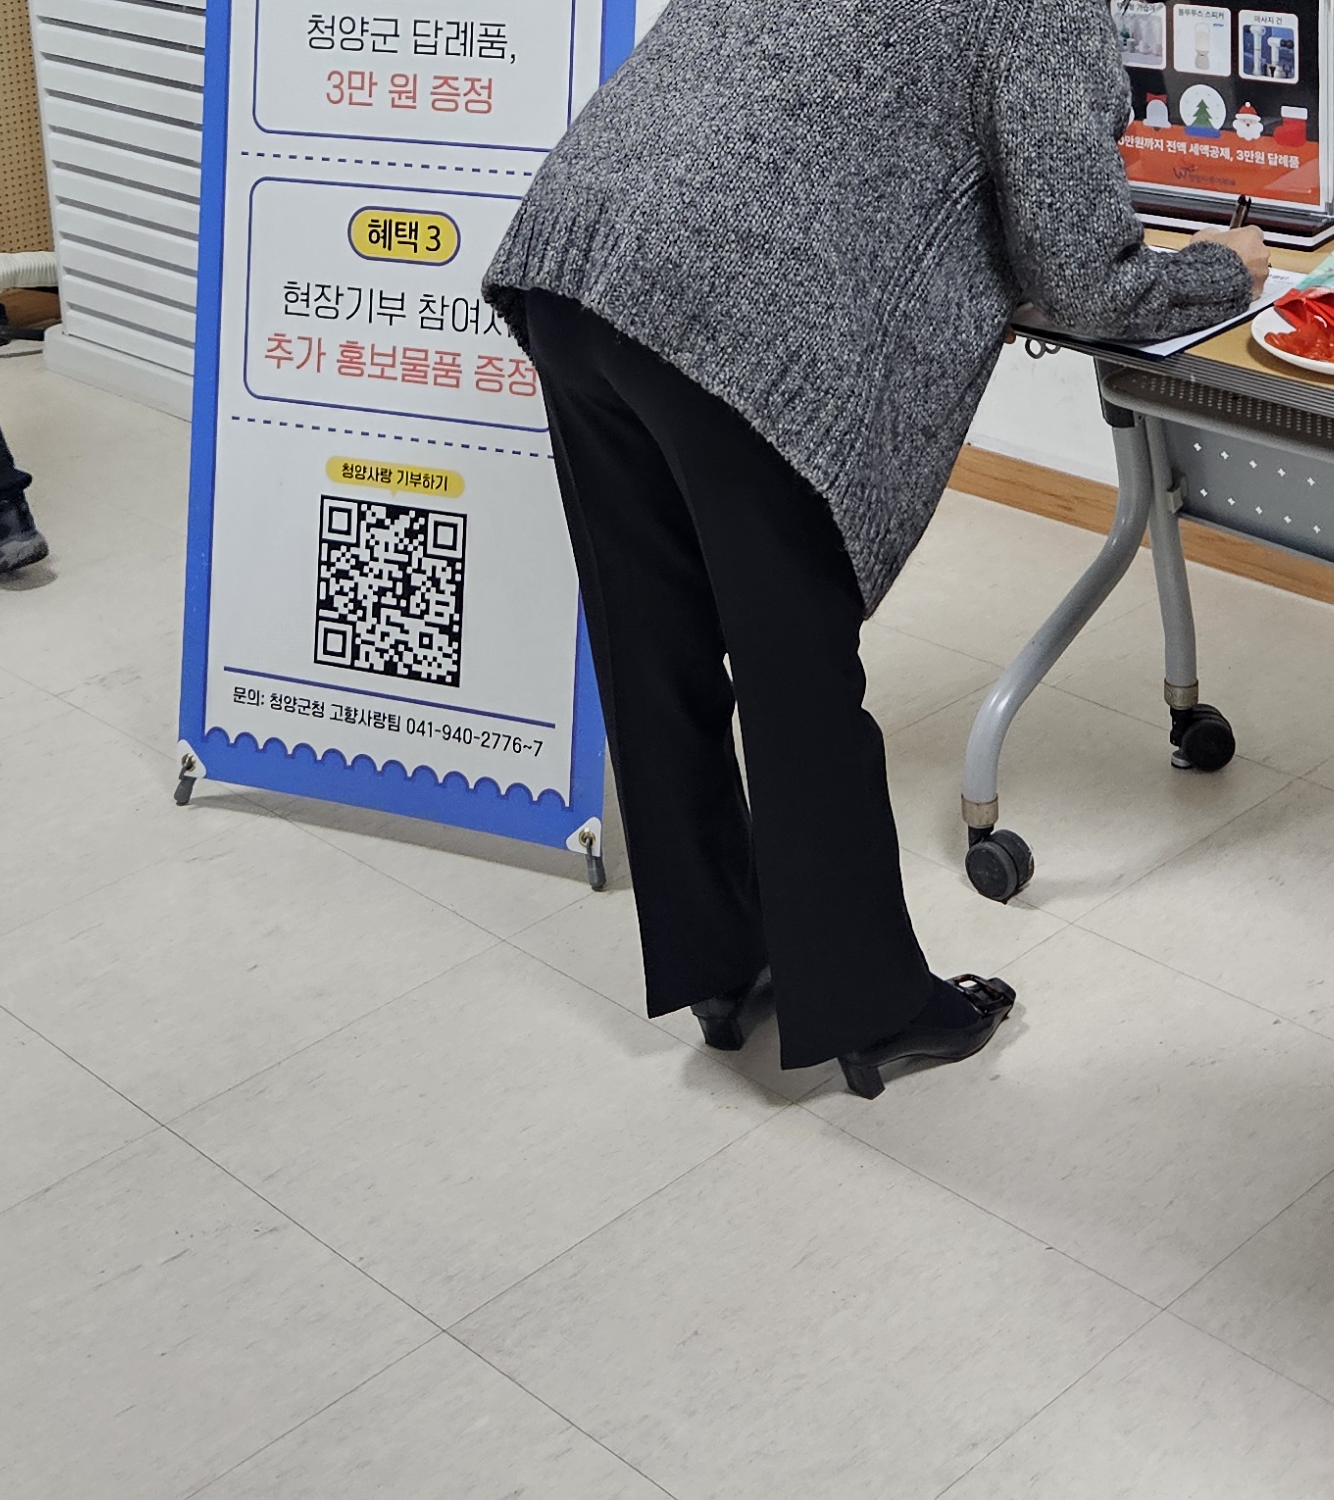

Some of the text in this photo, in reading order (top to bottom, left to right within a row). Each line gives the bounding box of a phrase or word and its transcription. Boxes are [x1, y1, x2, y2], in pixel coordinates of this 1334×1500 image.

[307, 13, 517, 64] 청양군 답례품,
[326, 69, 494, 115] 3만 원 증정
[1166, 139, 1187, 155] 전액
[1189, 143, 1233, 162] 세액공제,
[1236, 149, 1265, 164] 3만원
[1267, 153, 1300, 169] 답례품
[367, 218, 441, 254] 혜택 3
[283, 280, 407, 327] 현장기부
[265, 333, 538, 397] 추가 홍보물품 증정
[342, 462, 449, 492] 청양사랑 기부하기
[233, 686, 543, 757] 문의: 청양군청 고향사랑팀 041-940-2776~7
